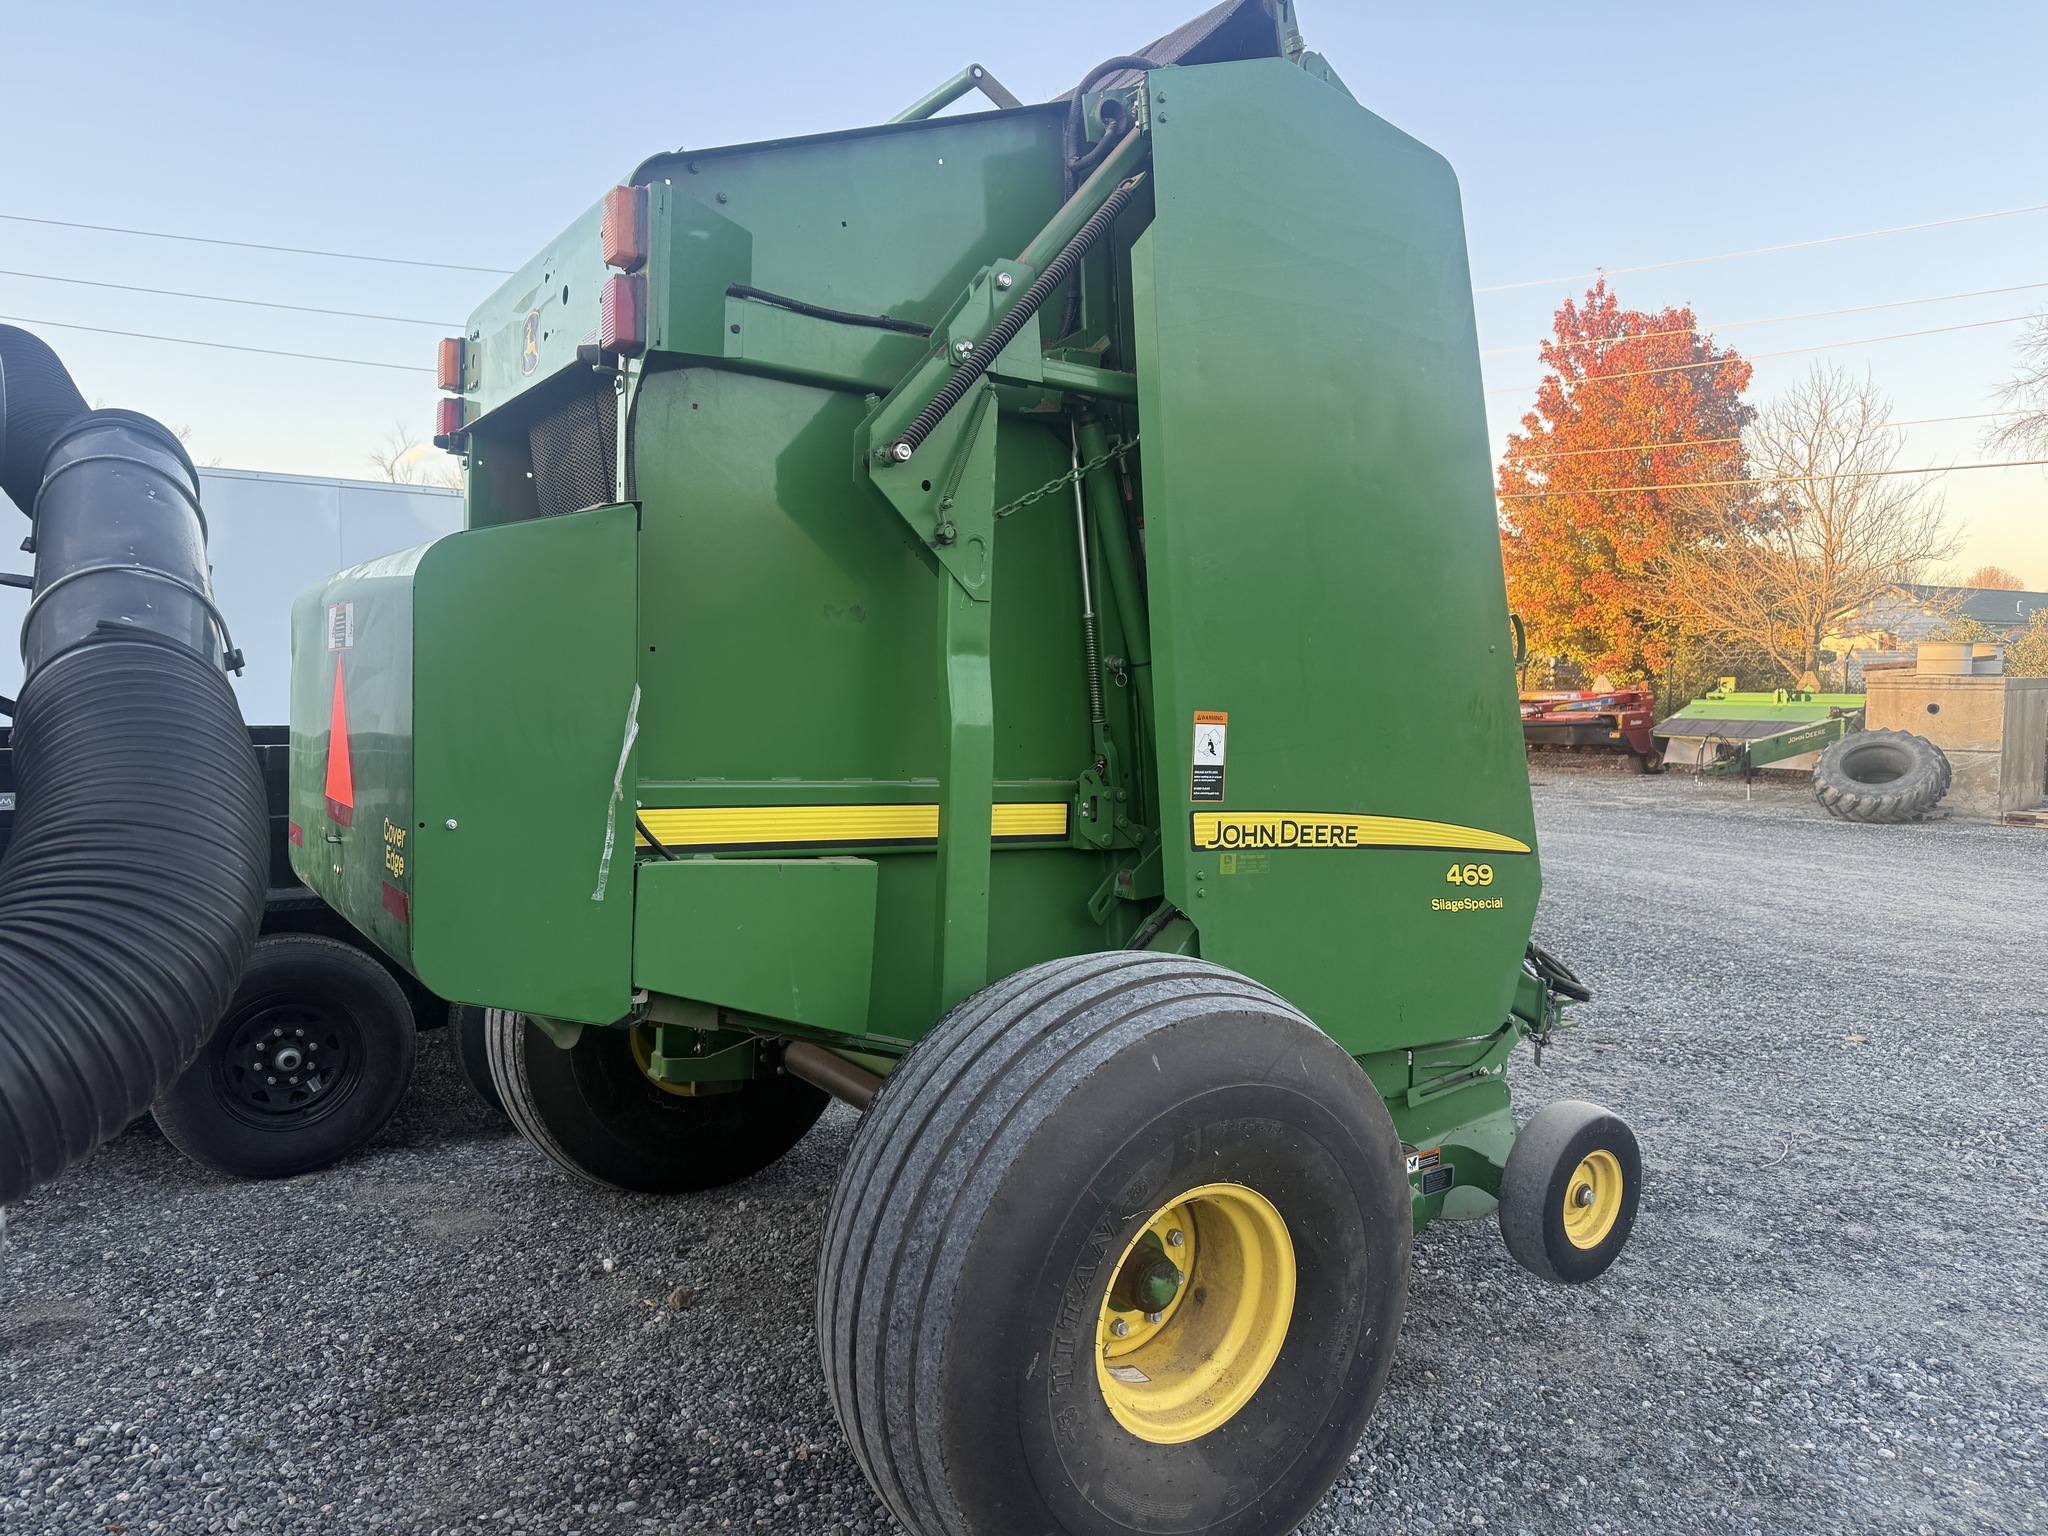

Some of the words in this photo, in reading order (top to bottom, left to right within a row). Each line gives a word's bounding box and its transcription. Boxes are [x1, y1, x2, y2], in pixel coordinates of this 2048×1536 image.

[1788, 734, 1805, 744] JOHN
[1805, 728, 1826, 739] DEERE
[383, 816, 406, 848] Cover
[1207, 820, 1276, 845] JOHN
[1280, 820, 1359, 844] DEERE
[385, 844, 404, 878] Edge
[1446, 864, 1494, 886] 469
[1431, 896, 1504, 912] SilageSpecial
